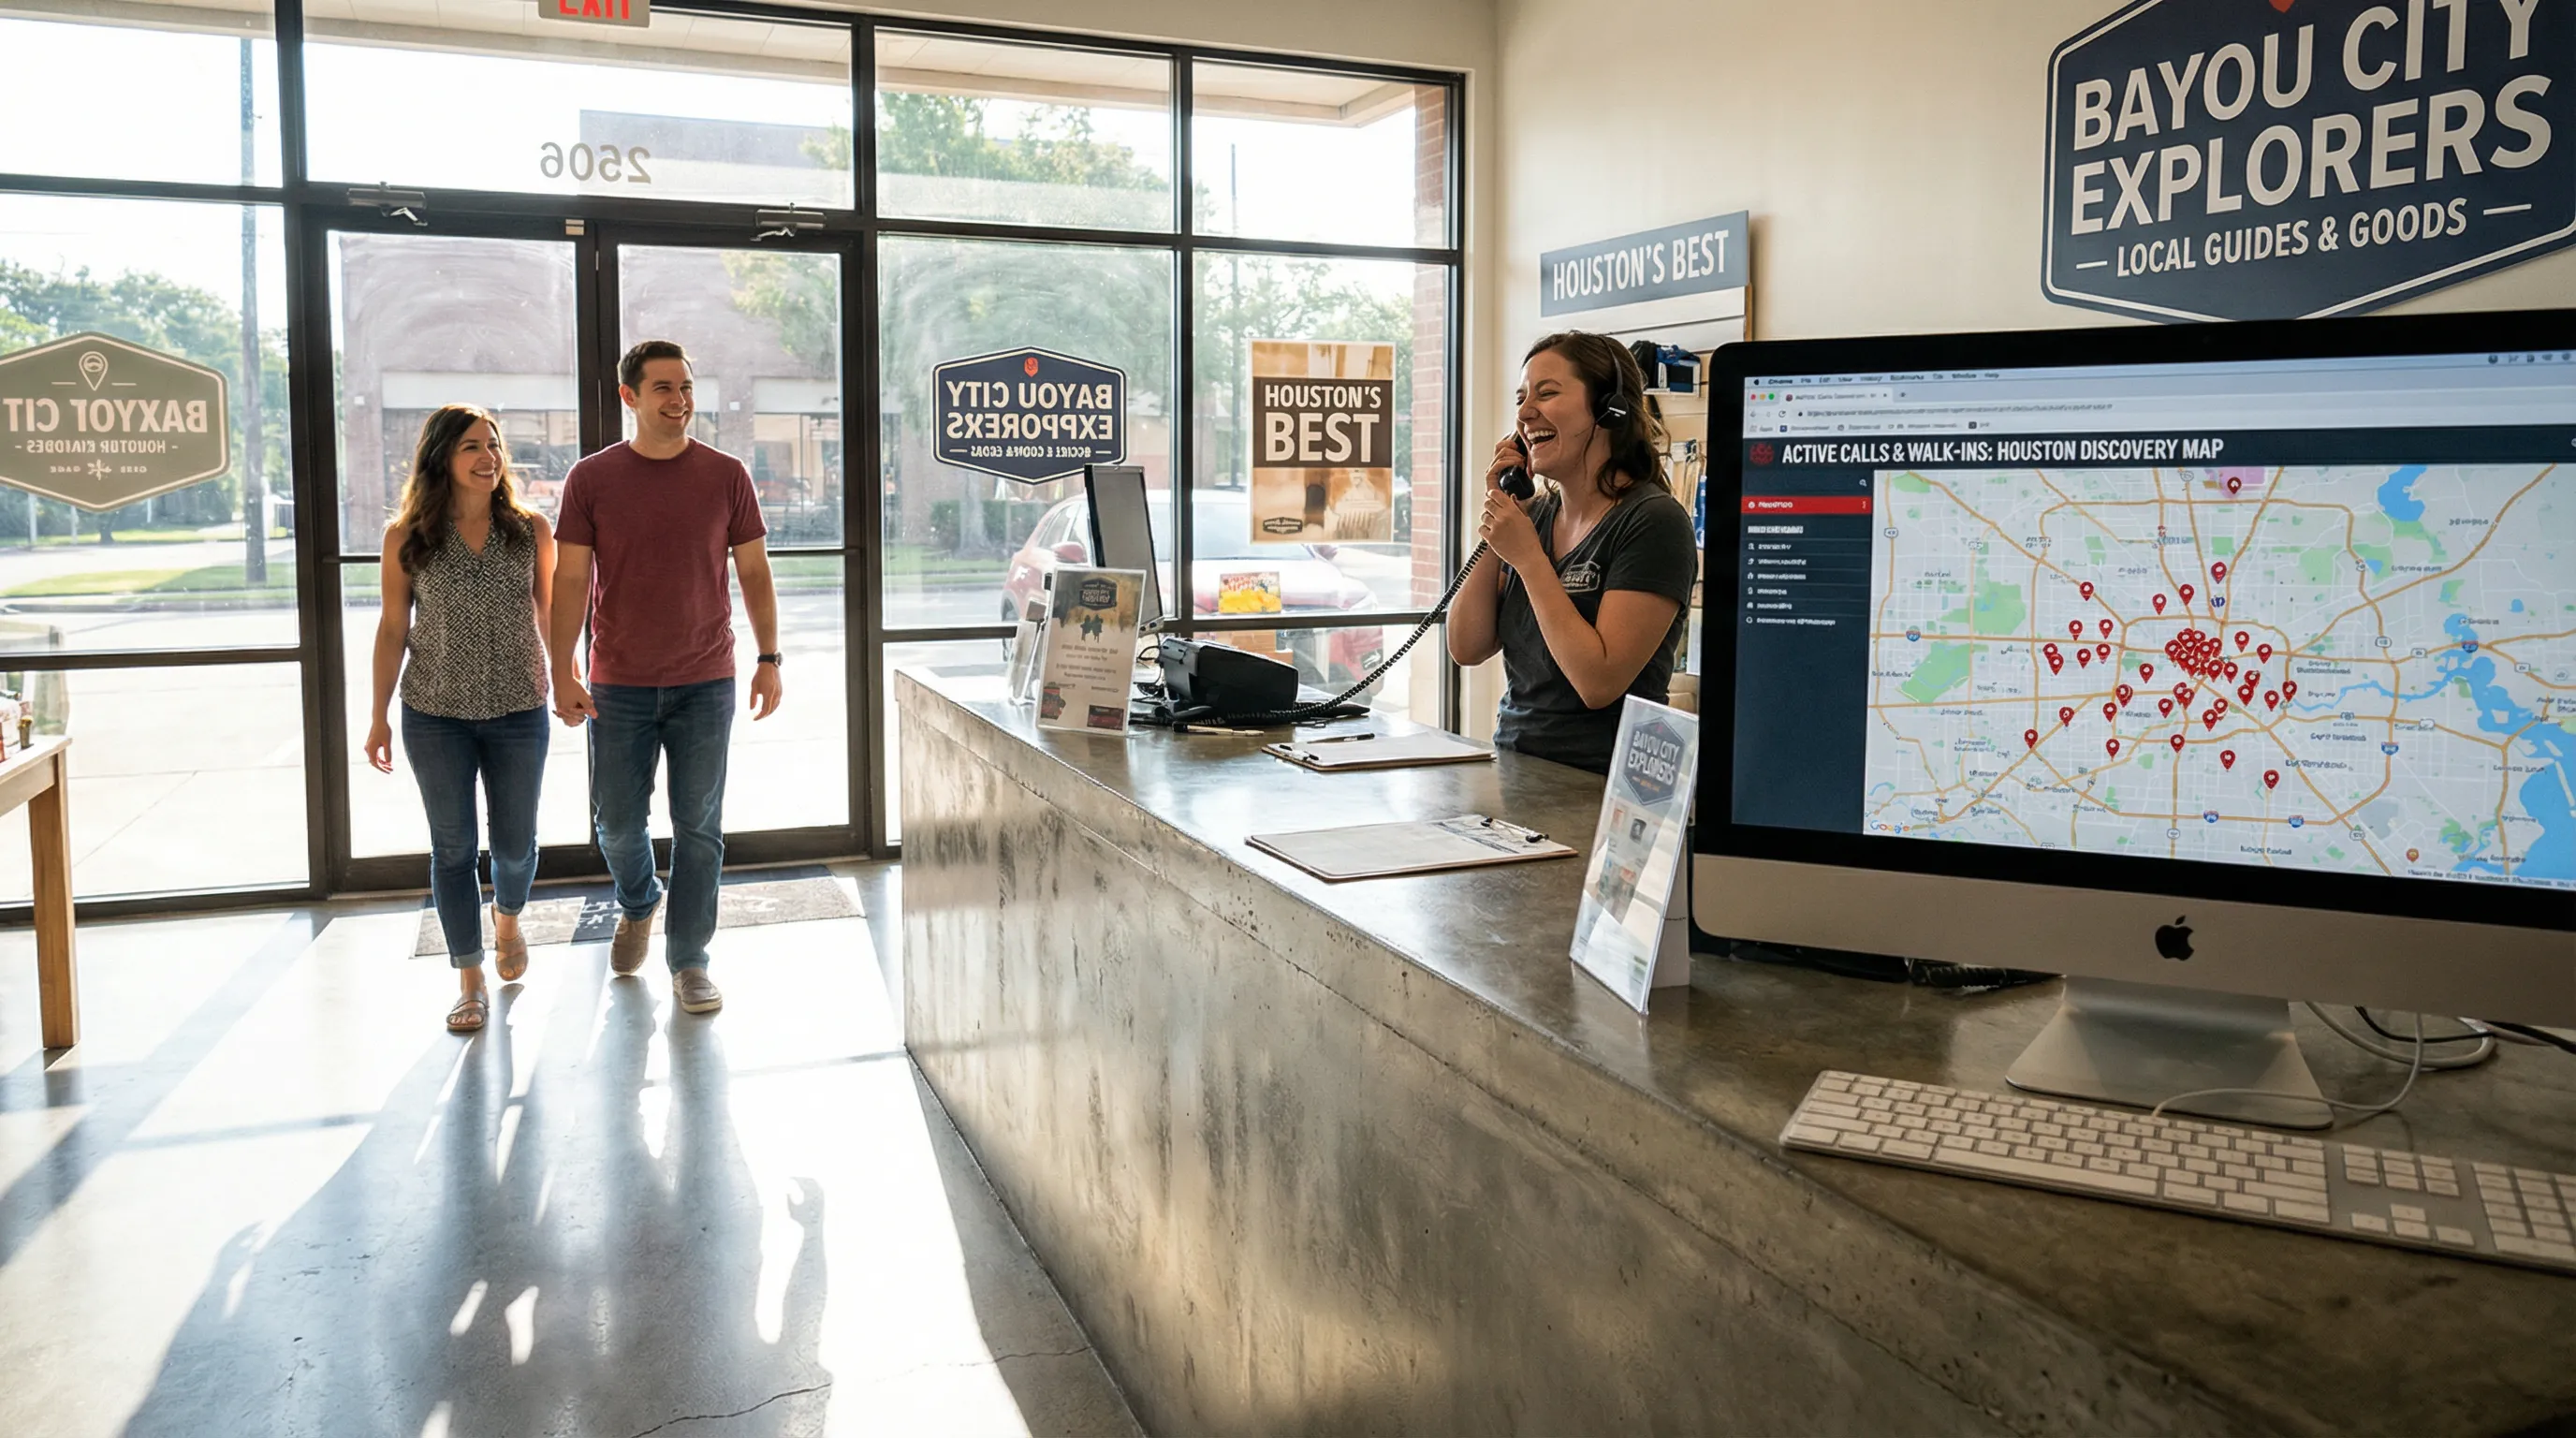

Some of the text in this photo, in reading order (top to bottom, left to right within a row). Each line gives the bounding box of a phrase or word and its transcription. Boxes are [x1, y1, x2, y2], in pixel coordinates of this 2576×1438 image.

[2072, 0, 2539, 152] BAYOU CITY
[2071, 74, 2553, 236] EXPLORERS
[1553, 228, 1729, 301] HOUSTON'S BEST
[2116, 198, 2467, 277] LOCAL GUIDES & GOODS
[1265, 384, 1382, 409] HOUSTON'S
[1266, 412, 1380, 462] BEST
[1782, 438, 2224, 463] ACTIVE CALLS & WALK-INS: HOUSTON DISCOVERY MAP
